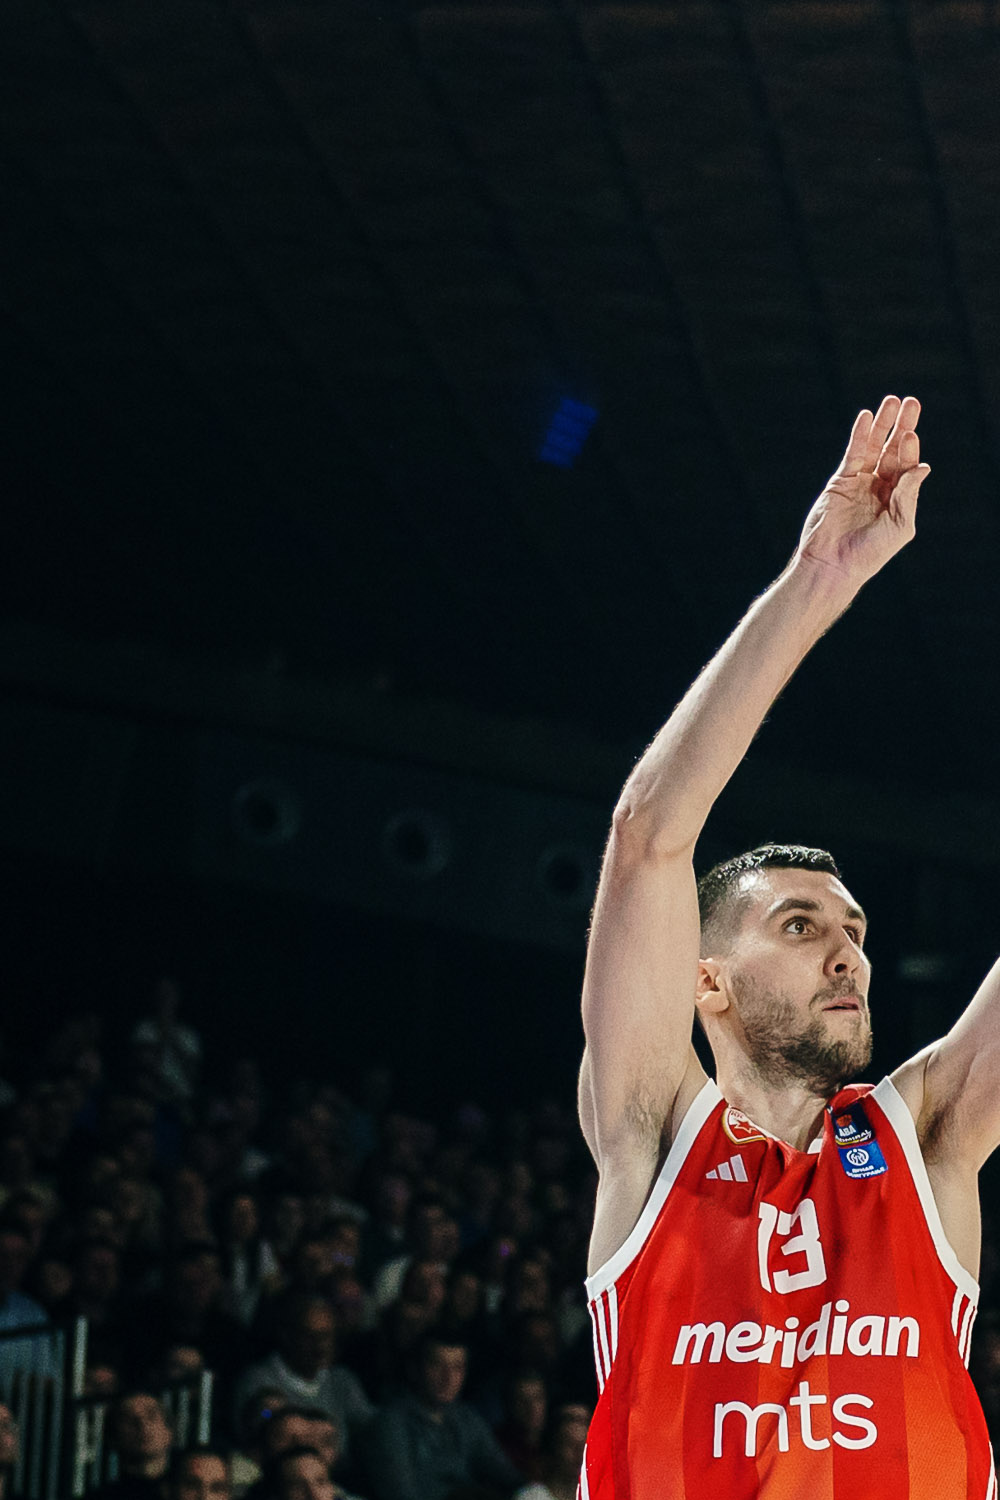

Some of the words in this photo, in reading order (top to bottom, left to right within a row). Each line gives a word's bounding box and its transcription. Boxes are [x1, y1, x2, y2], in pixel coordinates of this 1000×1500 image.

[757, 1198, 828, 1294] 13
[671, 1299, 920, 1368] meridian
[713, 1381, 878, 1458] mts
